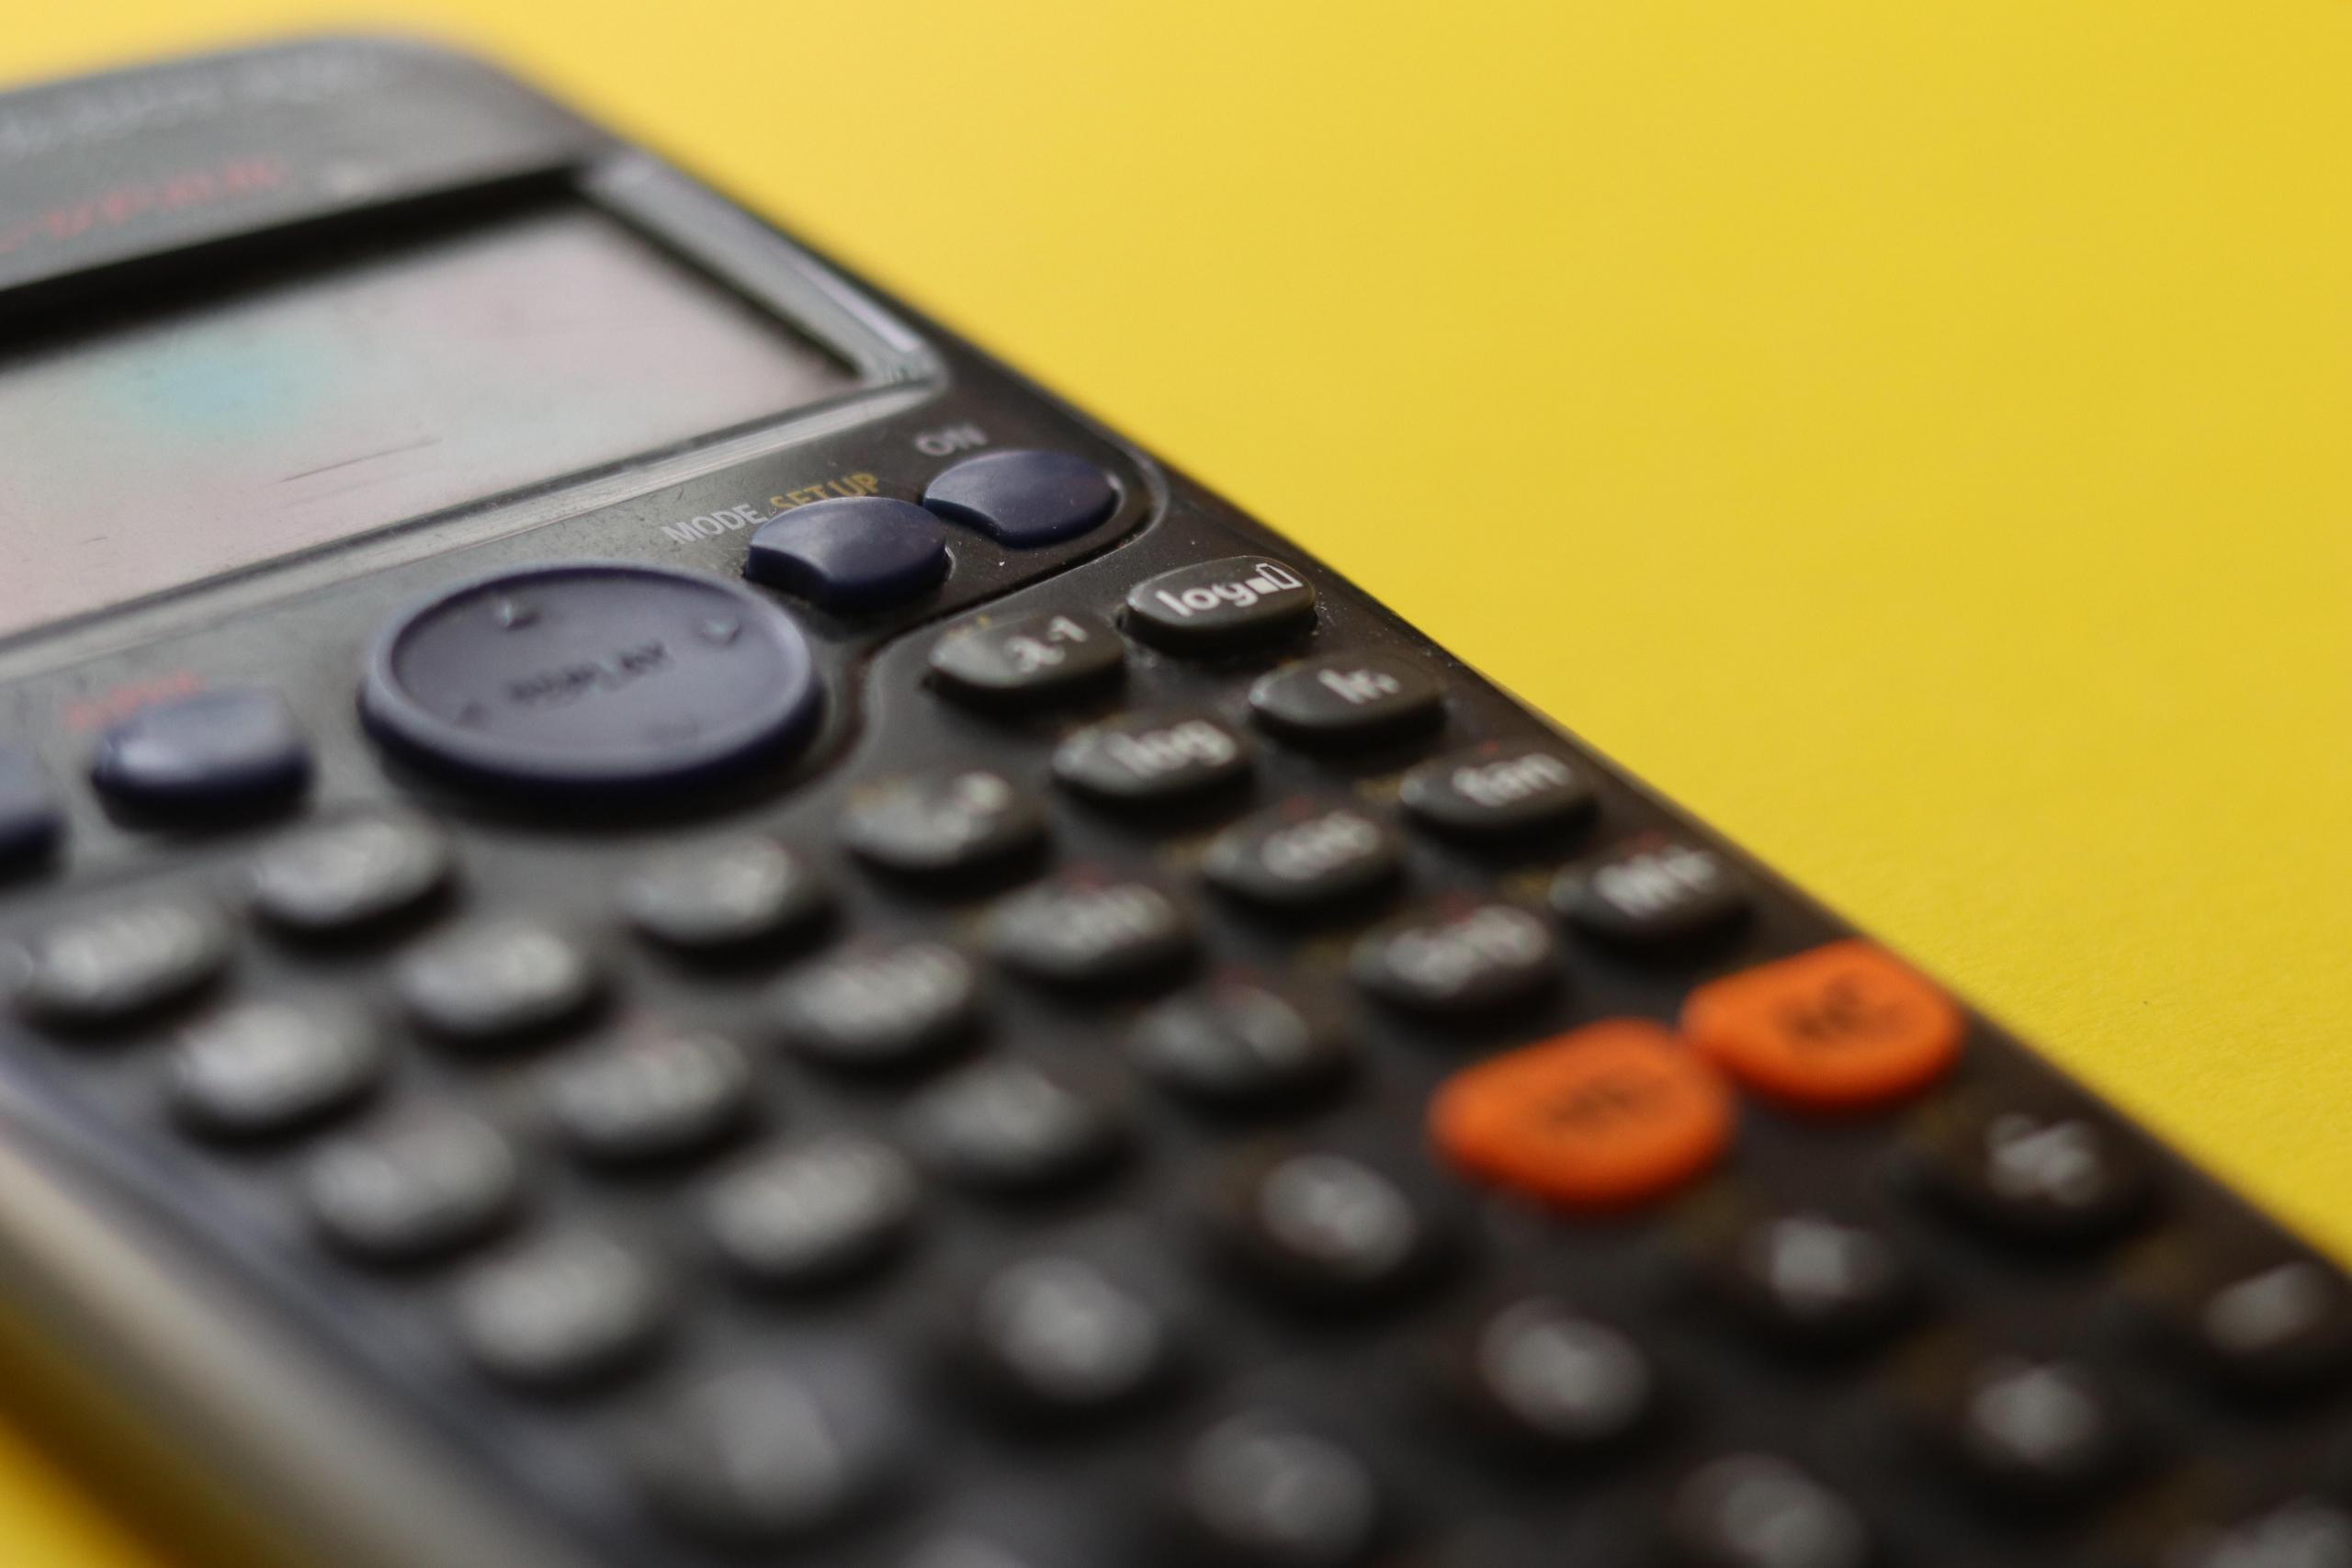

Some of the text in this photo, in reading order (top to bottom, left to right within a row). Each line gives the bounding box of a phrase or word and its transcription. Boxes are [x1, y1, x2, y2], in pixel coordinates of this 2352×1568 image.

[661, 472, 879, 544] MODE SET UP
